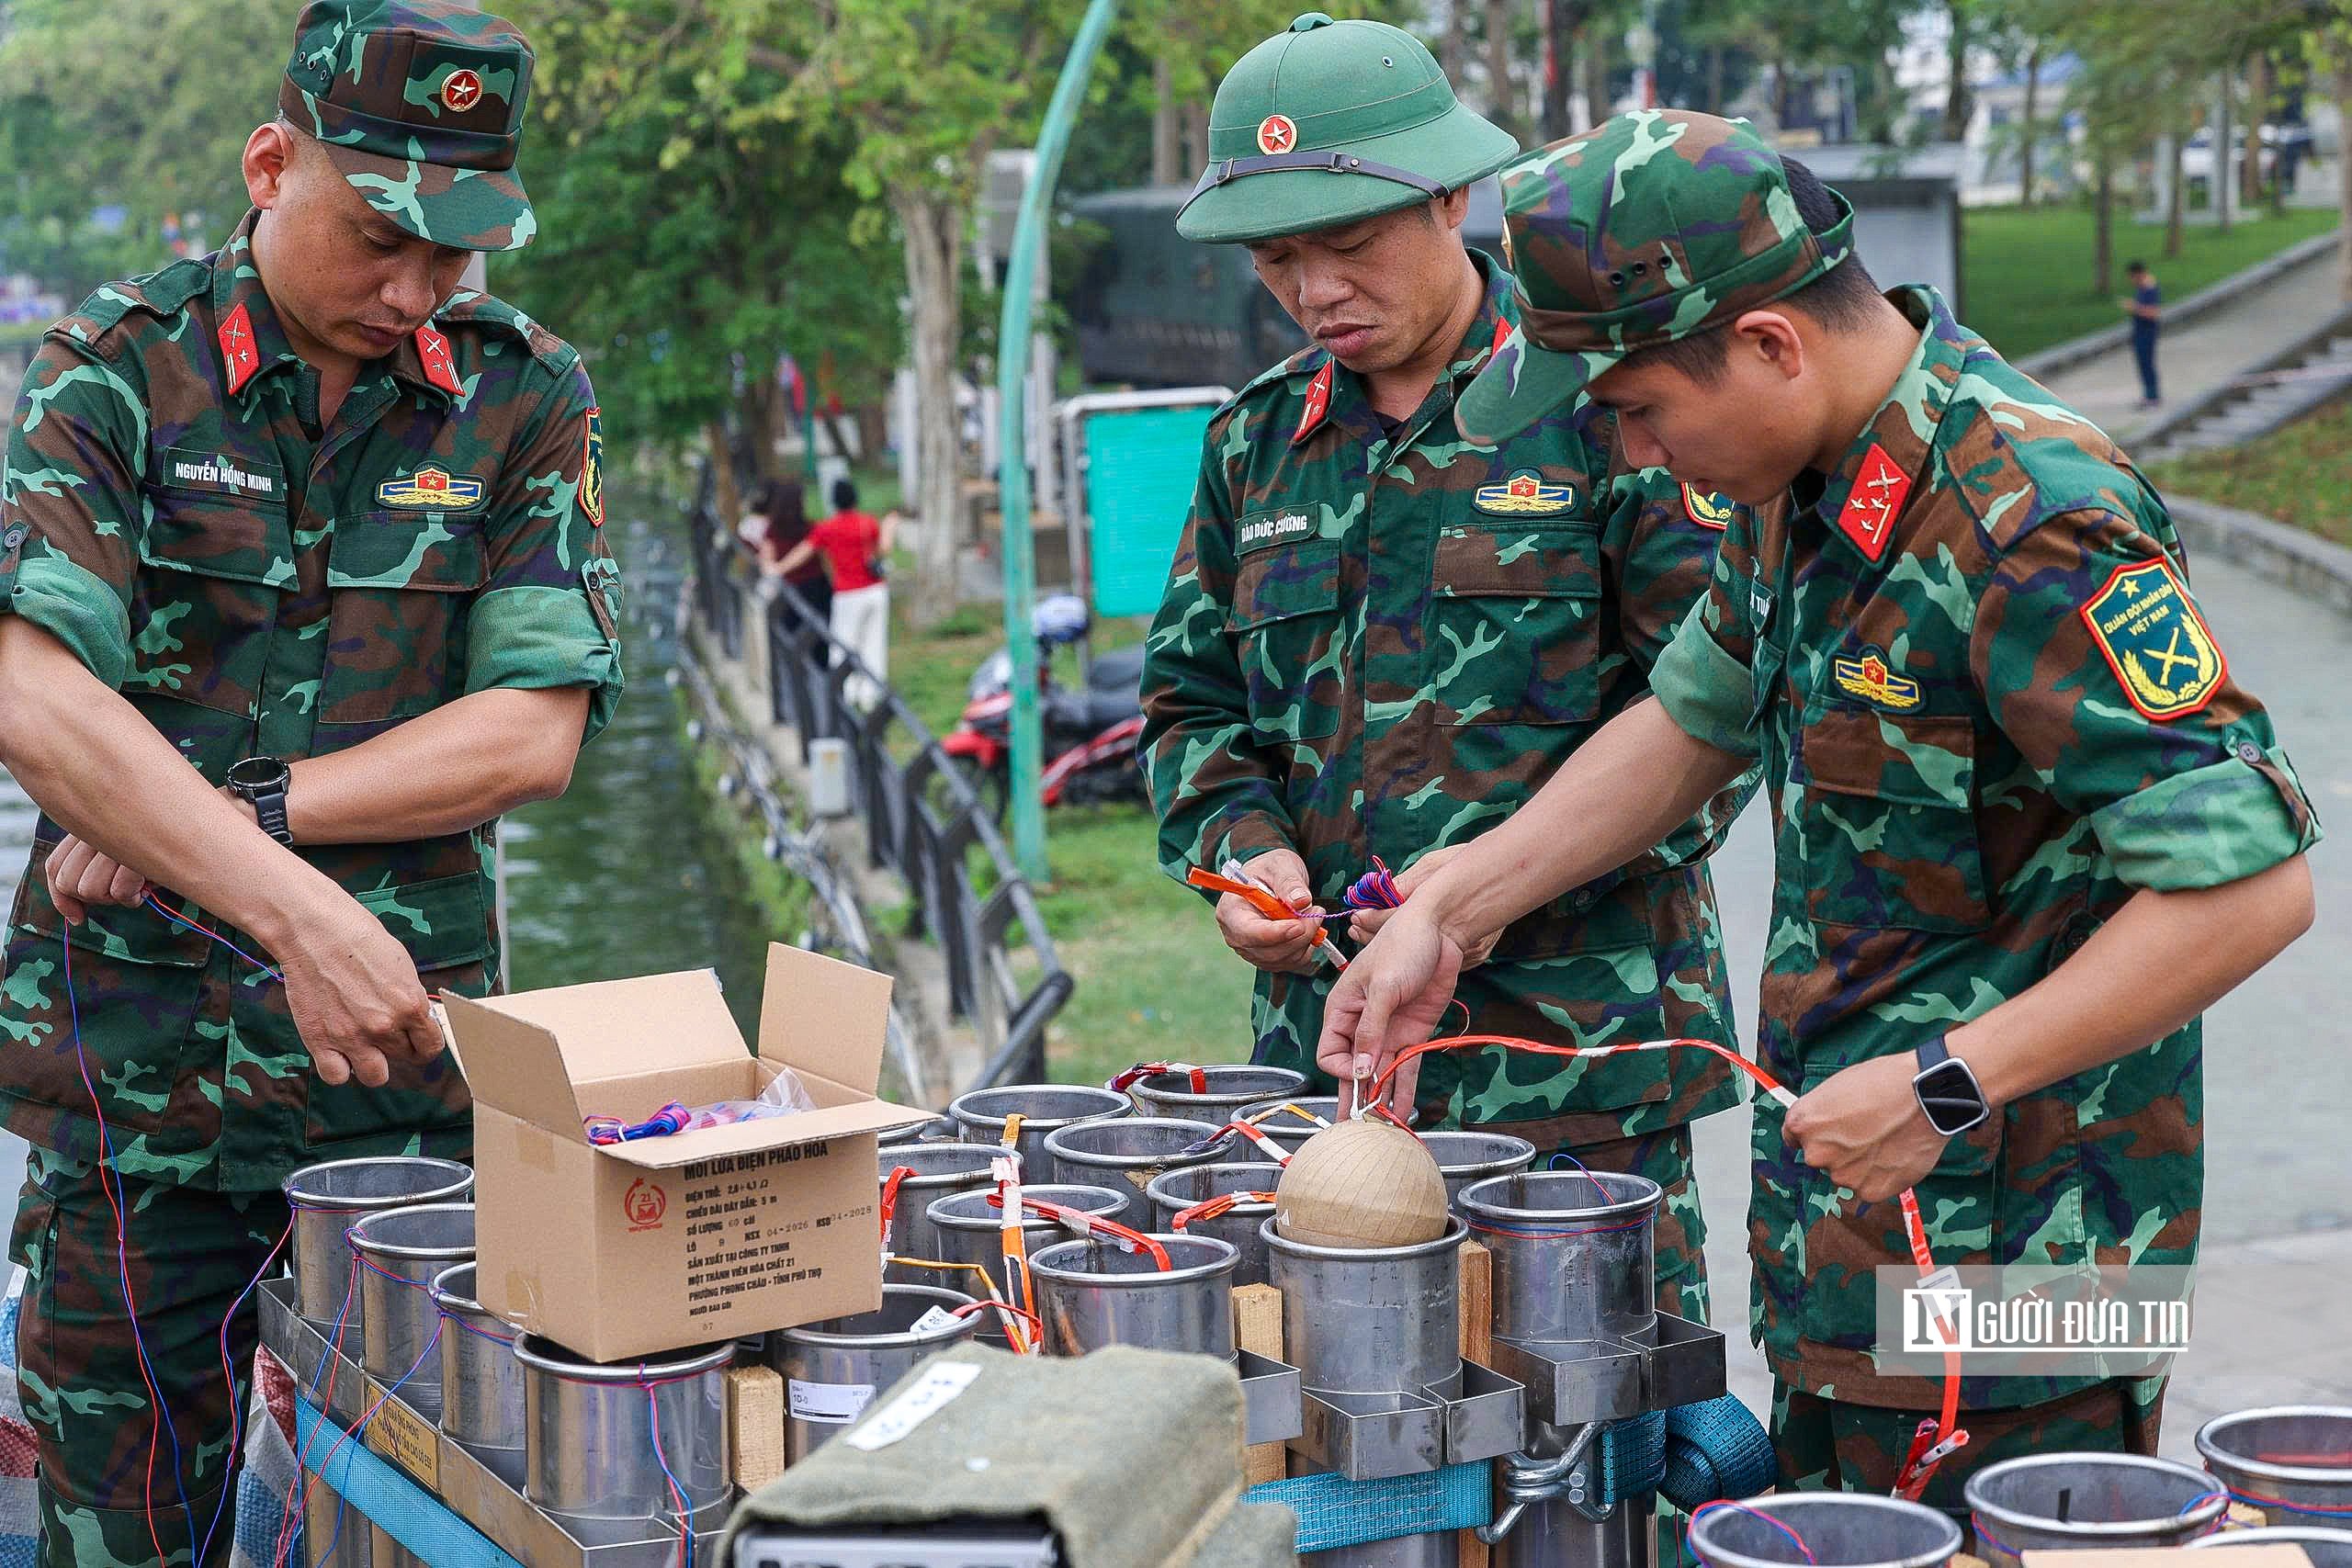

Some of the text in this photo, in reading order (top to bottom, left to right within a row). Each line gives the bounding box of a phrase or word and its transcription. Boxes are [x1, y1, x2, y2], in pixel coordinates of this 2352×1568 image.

[175, 460, 273, 492] NGUYỄN HỒNG MINH
[1274, 513, 1307, 535] CƯỜNG
[2103, 612, 2129, 635] QUÂN
[2125, 603, 2143, 620] ĐỘI
[2138, 591, 2162, 611] NHÂN
[2128, 604, 2170, 637] VIỆT NAM
[686, 1223, 697, 1236] SỐ
[698, 1221, 723, 1235] LƯỢNG
[686, 1241, 697, 1253] LÔ
[744, 1230, 761, 1242] NSX
[687, 1256, 704, 1269] SẢN
[704, 1251, 724, 1266] XUẤT
[738, 1247, 759, 1261] CÔNG
[760, 1245, 770, 1257] TY
[687, 1273, 704, 1287] MỘT
[706, 1269, 730, 1283] THÀNH
[731, 1265, 749, 1278] VIÊN
[765, 1257, 785, 1271] CHẤT
[786, 1257, 796, 1268] 21
[720, 1281, 746, 1296] PHONG
[746, 1277, 767, 1291] CHÂU
[808, 1267, 822, 1280] THỌ
